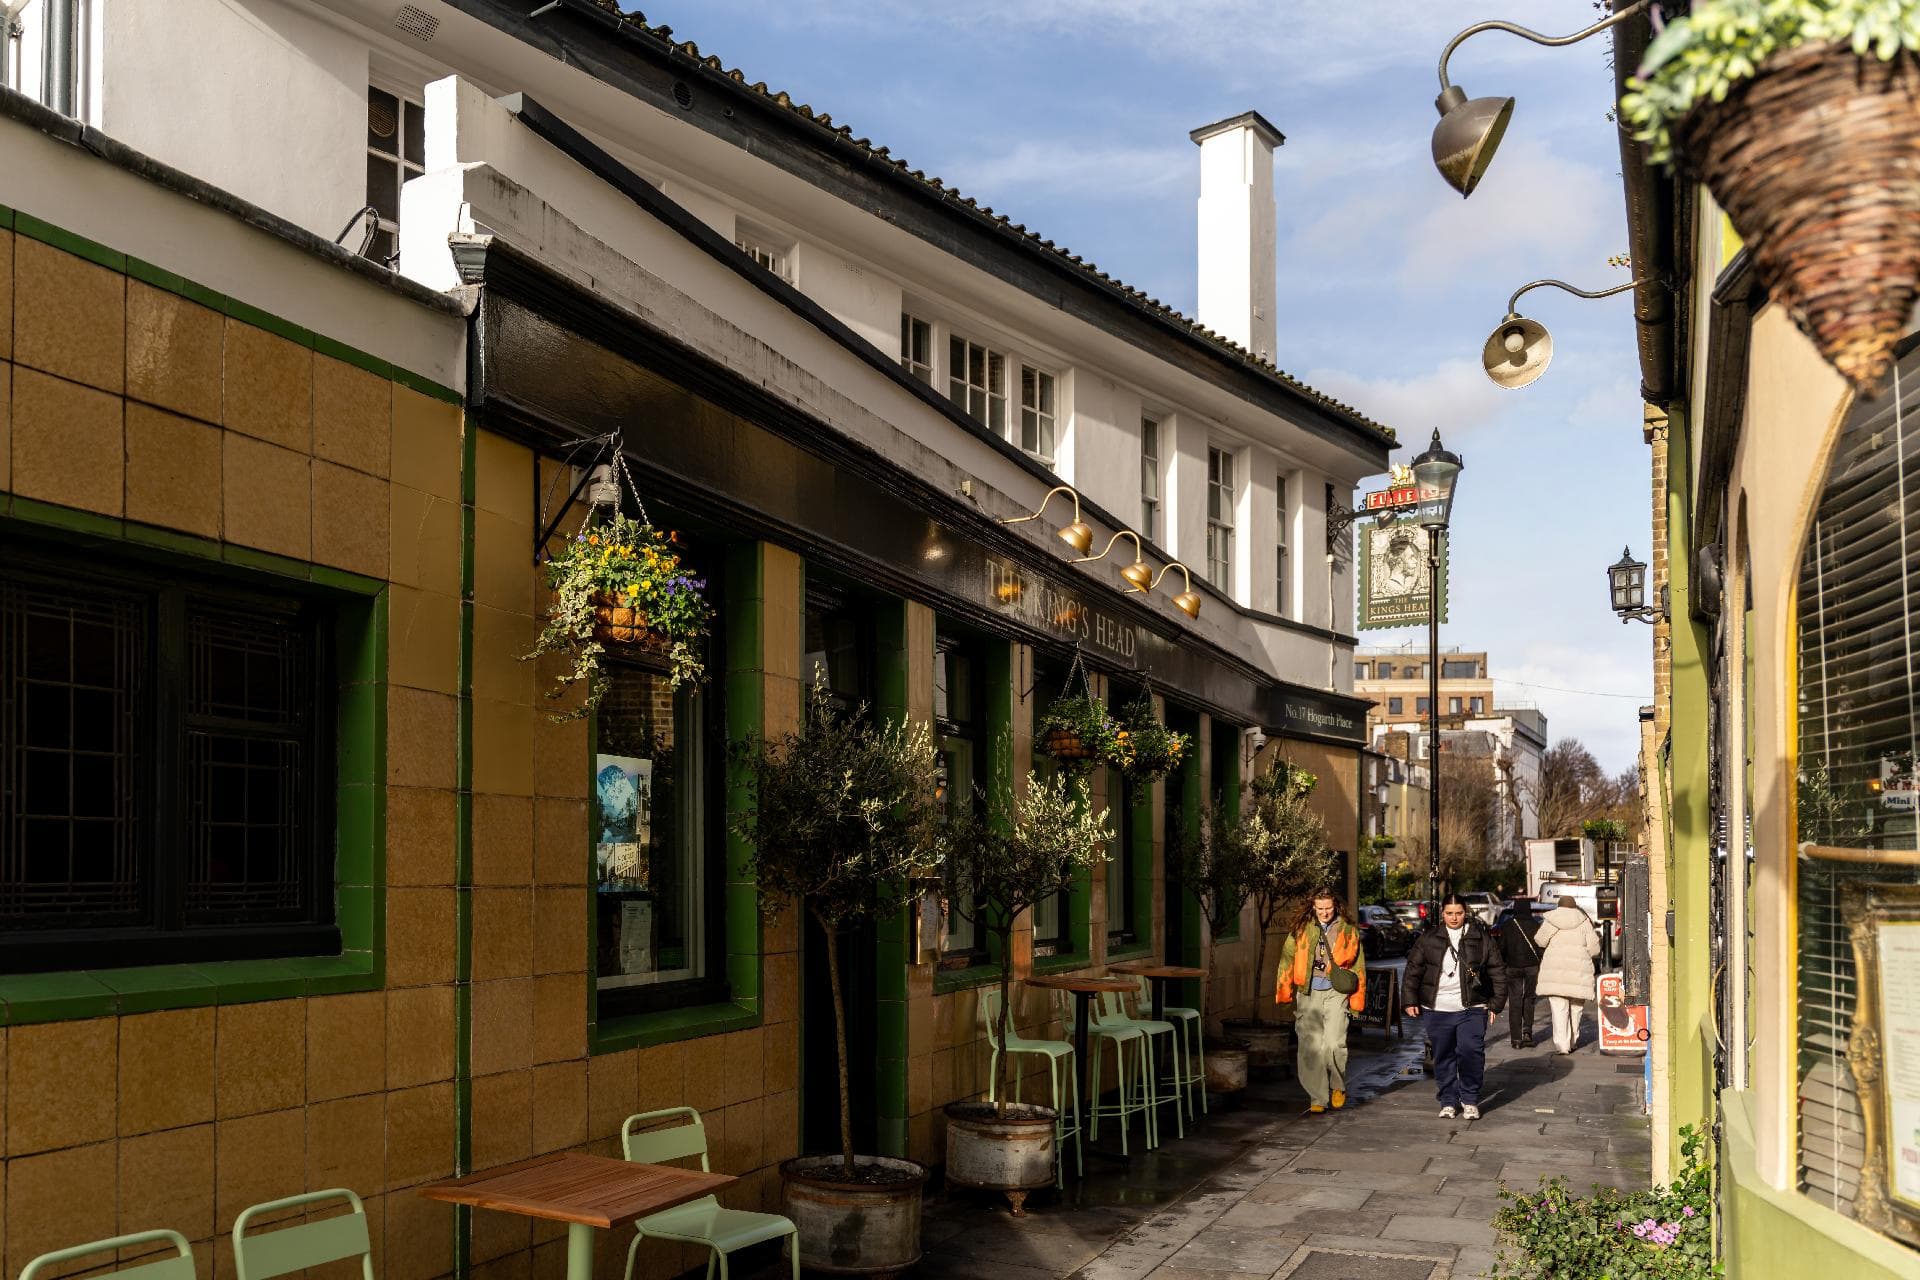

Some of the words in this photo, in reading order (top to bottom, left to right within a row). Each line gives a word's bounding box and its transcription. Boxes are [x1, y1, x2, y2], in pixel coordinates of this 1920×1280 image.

[1394, 596, 1409, 604] THE
[1370, 604, 1400, 615] KINGS
[1033, 583, 1089, 638] KING'S
[1095, 612, 1135, 657] HEAD
[1307, 707, 1335, 727] Hogarth
[1336, 713, 1353, 729] Place
[1887, 796, 1910, 805] Mini
